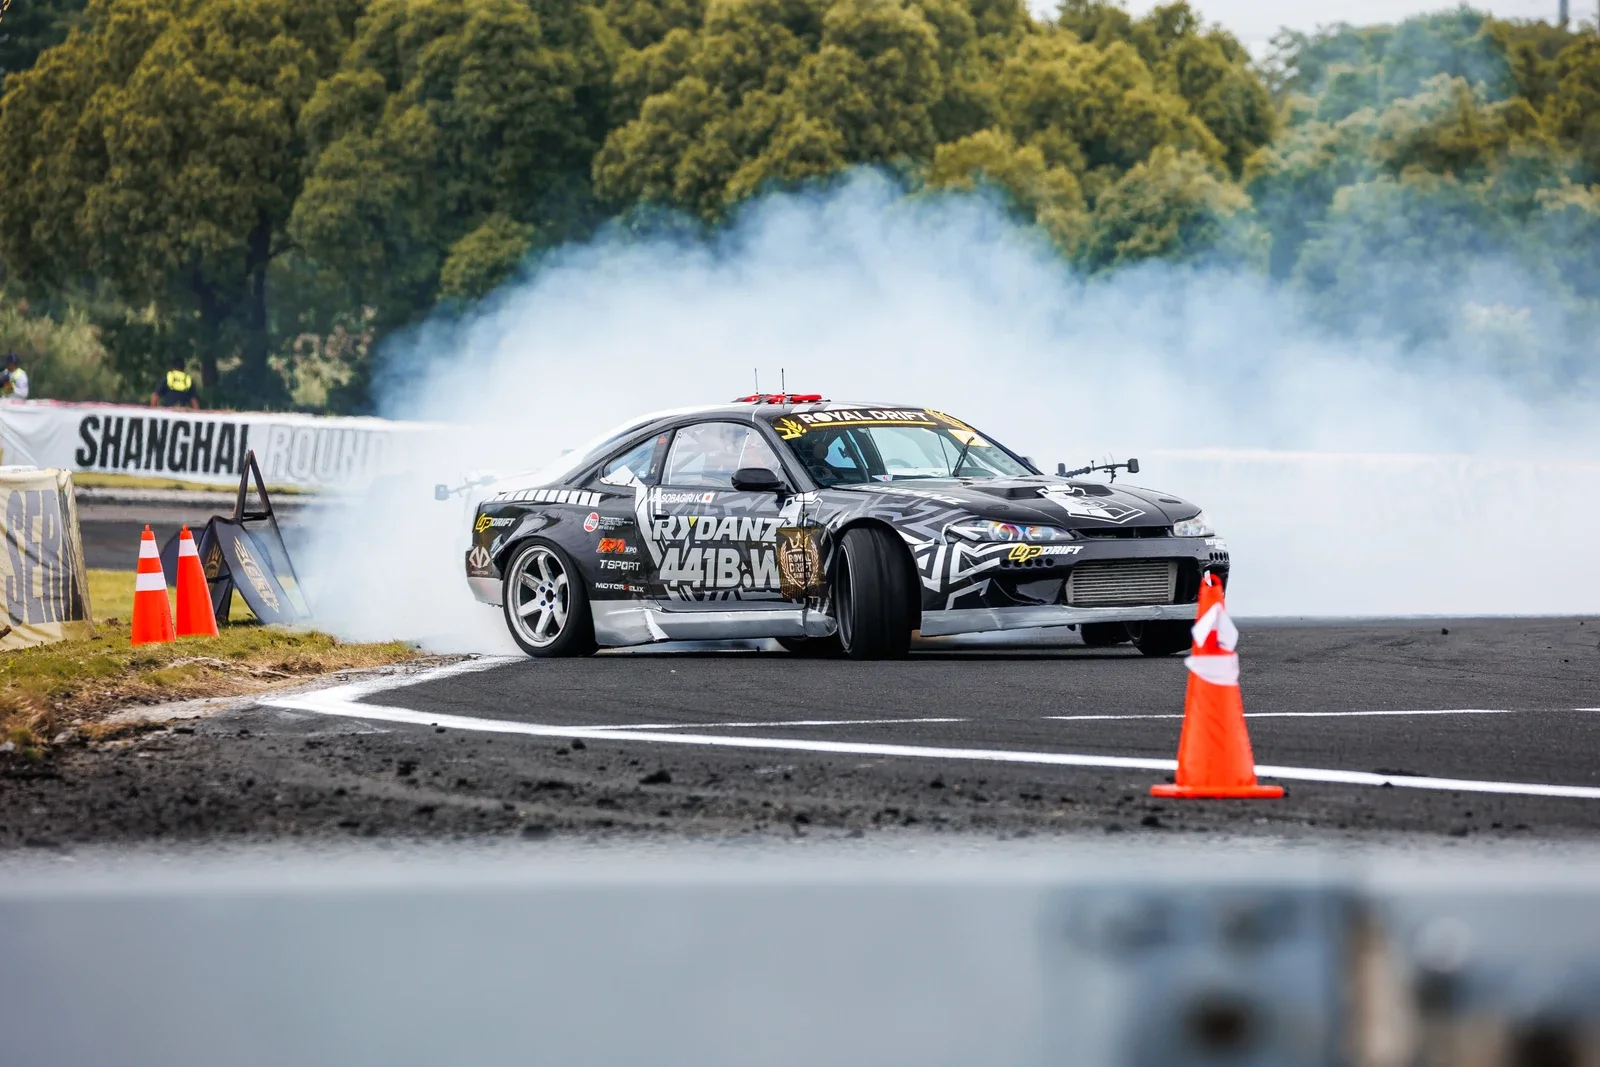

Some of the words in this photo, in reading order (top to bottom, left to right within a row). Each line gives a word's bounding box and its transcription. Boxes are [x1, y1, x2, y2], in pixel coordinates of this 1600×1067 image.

[797, 410, 873, 424] ROYAL
[868, 410, 930, 422] DRIFT
[75, 414, 249, 475] SHANGHAI
[263, 424, 392, 481] ROUND
[652, 515, 788, 542] RYDANZ
